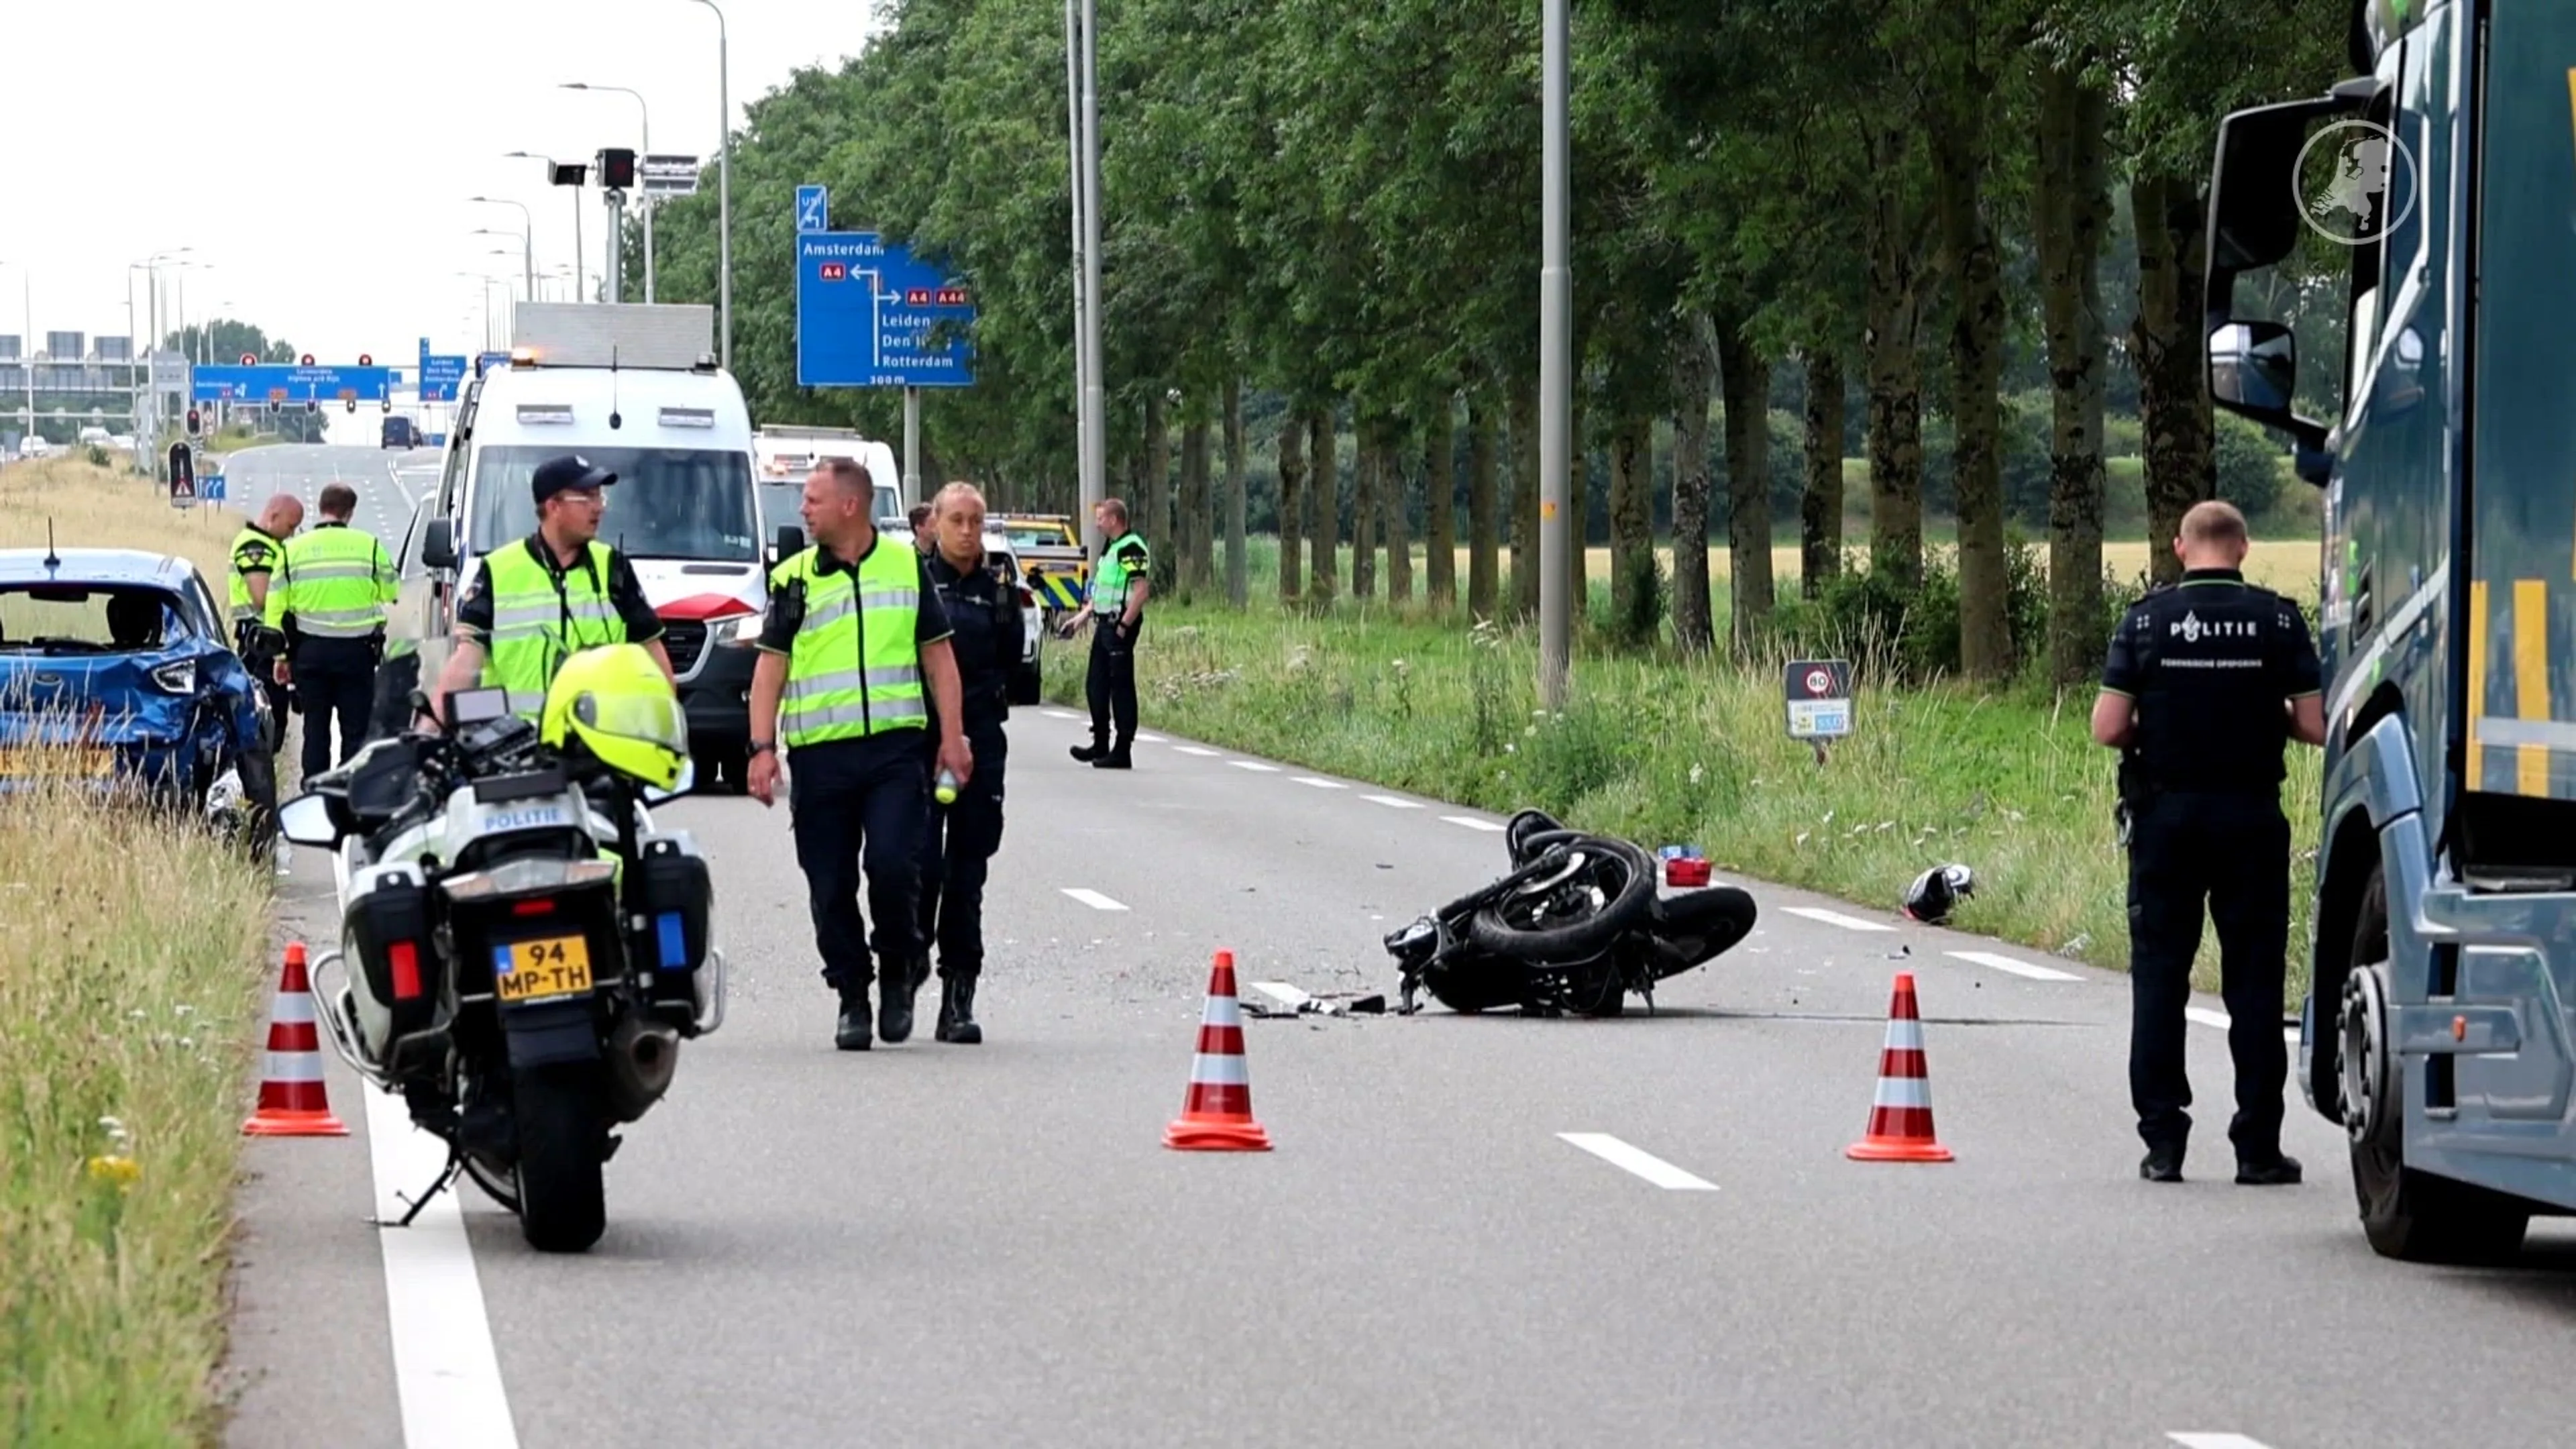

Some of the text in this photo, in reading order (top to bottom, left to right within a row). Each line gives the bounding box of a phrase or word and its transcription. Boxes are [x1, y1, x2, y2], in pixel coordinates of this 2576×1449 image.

[824, 267, 842, 278] A4
[910, 292, 965, 303] A4 A44
[882, 315, 930, 327] Leiden
[882, 335, 910, 347] Den
[883, 356, 953, 368] Rotterdam
[869, 376, 905, 385] 300 m
[2170, 614, 2257, 640] POLITIE
[484, 808, 561, 830] POLITIE
[529, 942, 566, 966] 94
[501, 965, 586, 996] MP-TH
